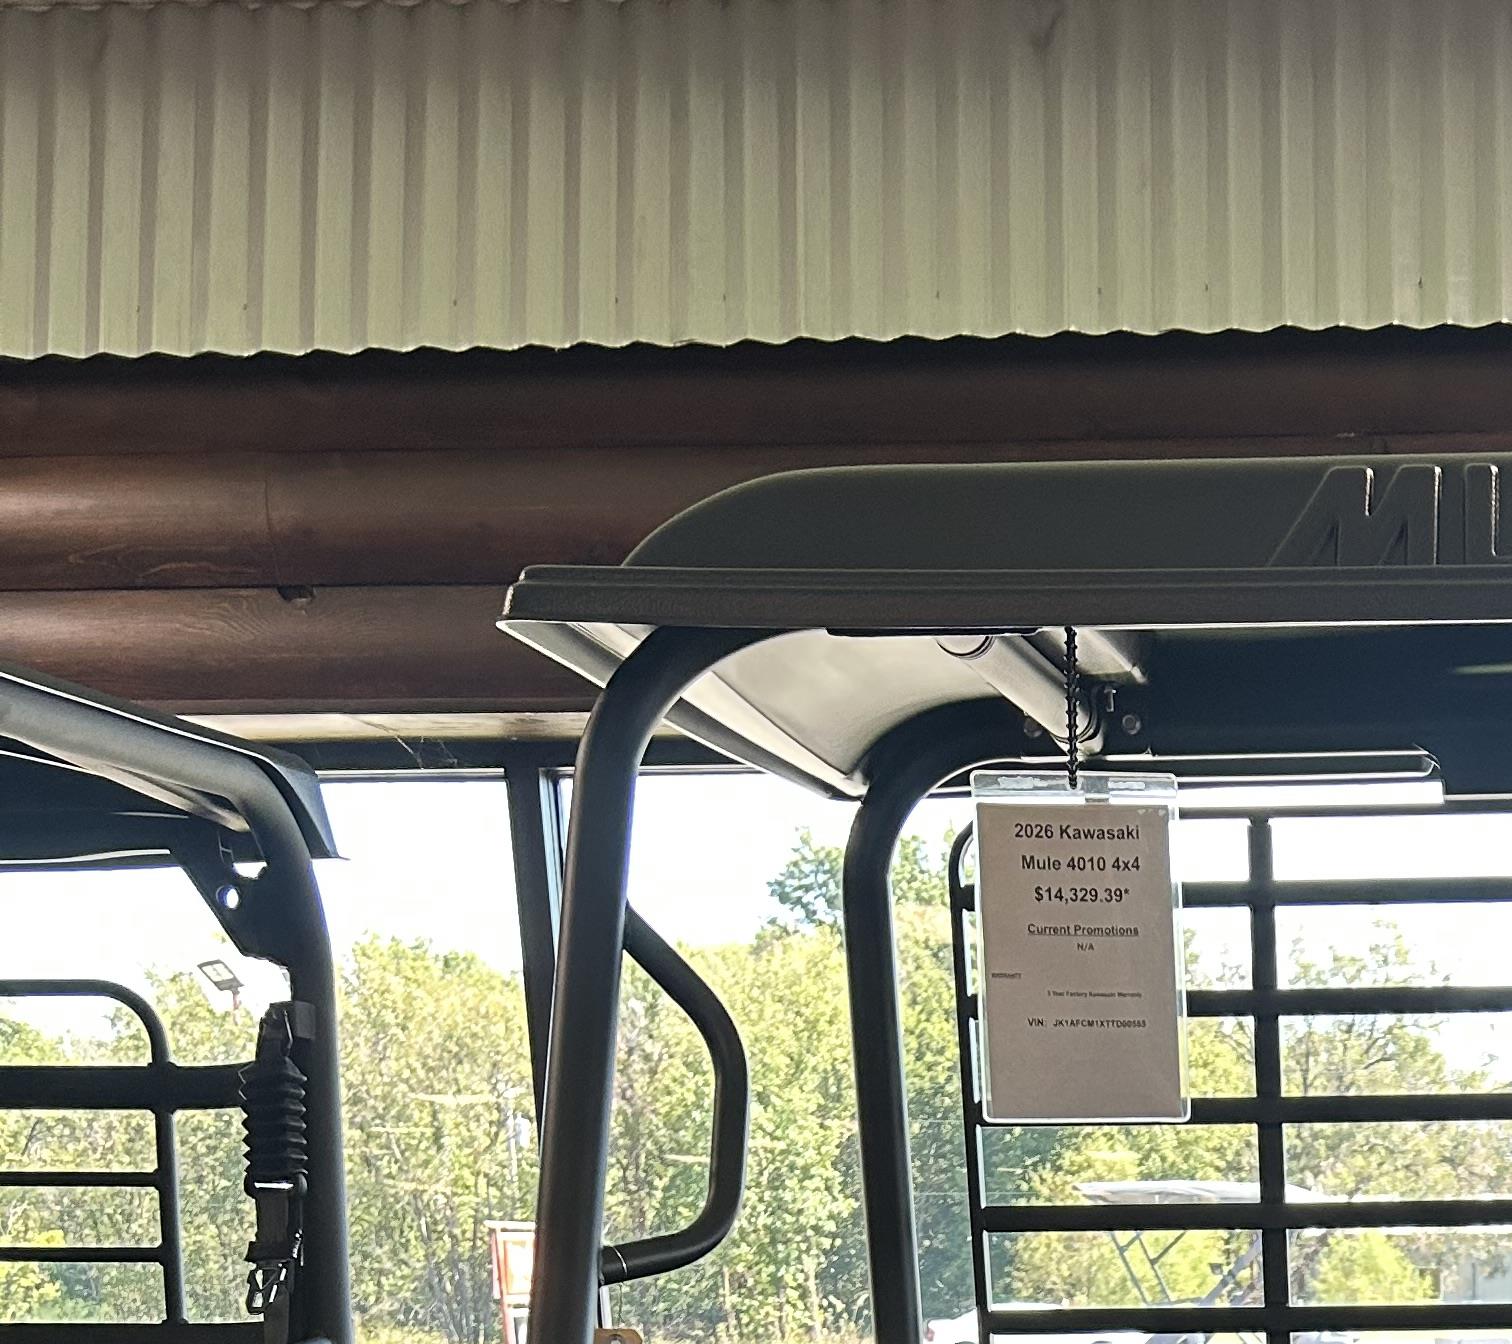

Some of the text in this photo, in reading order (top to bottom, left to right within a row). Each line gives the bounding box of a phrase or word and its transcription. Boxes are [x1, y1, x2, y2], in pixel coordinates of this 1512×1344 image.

[1014, 823, 1140, 841] 2026 Kawasaki
[1021, 855, 1141, 872] Mule 4010 4x4
[1027, 923, 1139, 937] Current Promotions
[1076, 942, 1095, 952] N/A
